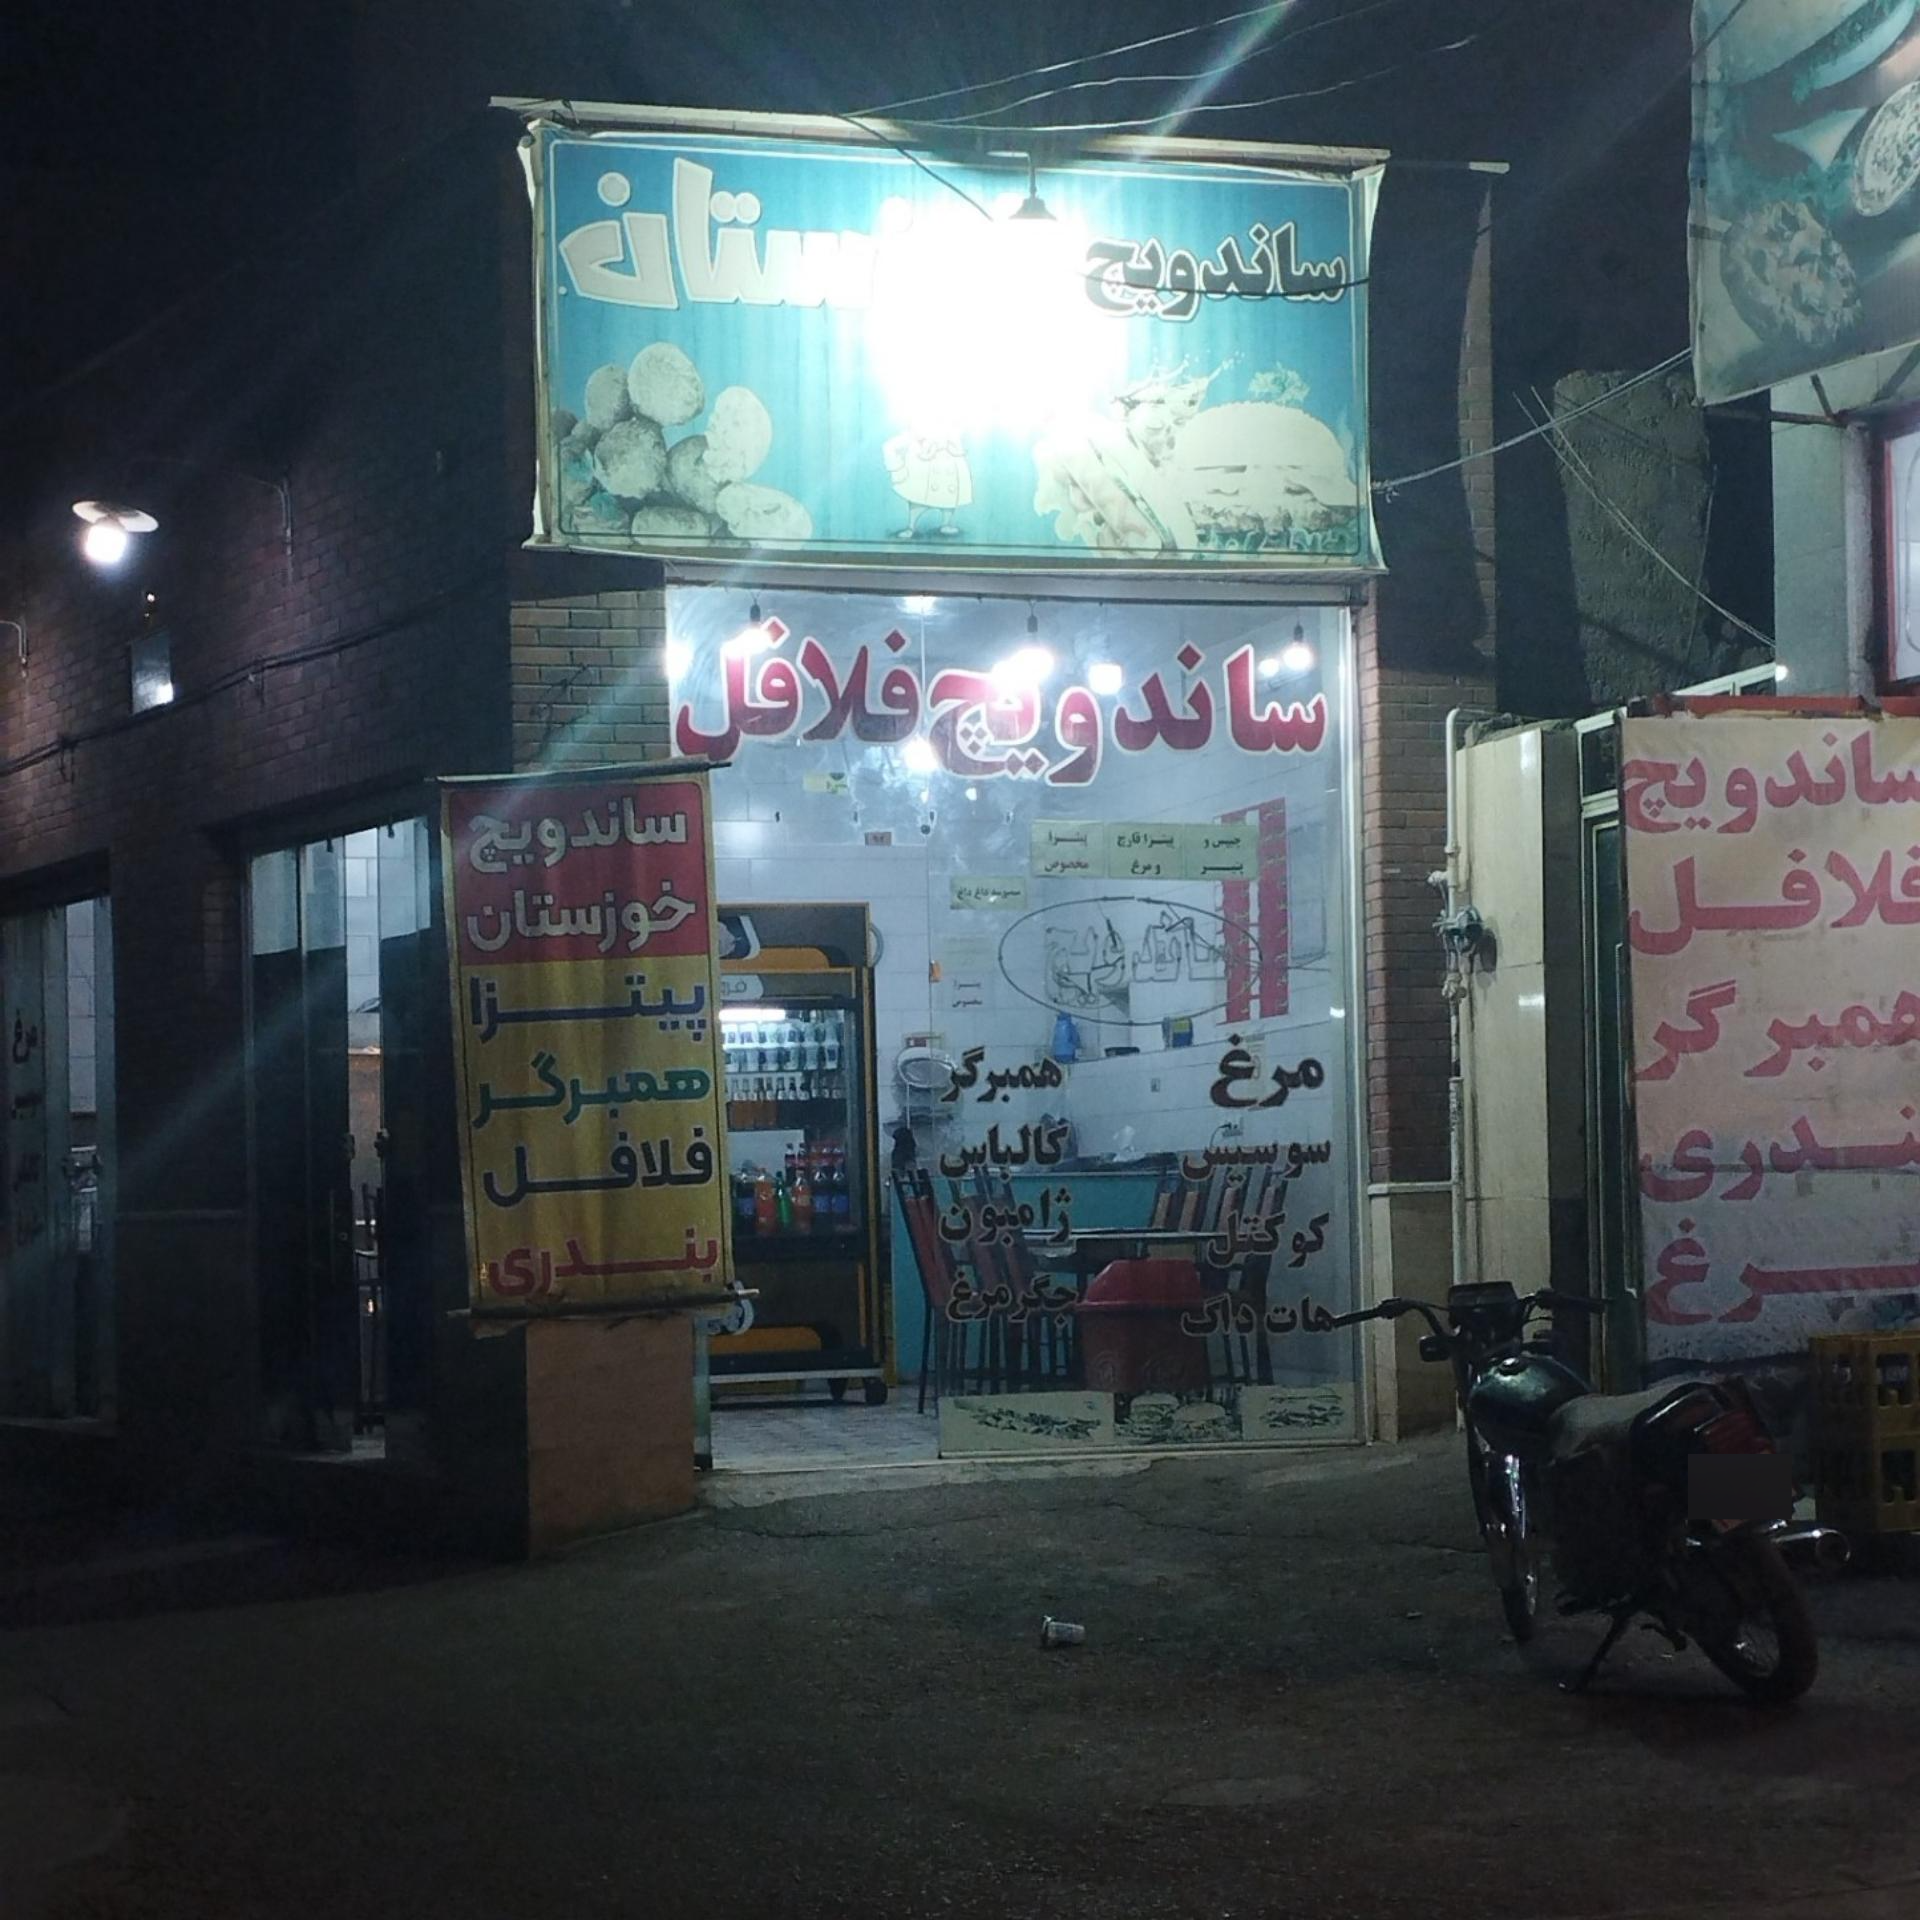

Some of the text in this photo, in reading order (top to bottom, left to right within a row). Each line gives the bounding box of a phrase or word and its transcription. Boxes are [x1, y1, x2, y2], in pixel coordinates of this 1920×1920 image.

[1084, 222, 1346, 321] ساندویچ
[675, 616, 1327, 786] ساندویچ فلافل
[469, 797, 687, 872] ساندویچ
[467, 880, 696, 951] خوزستان
[470, 974, 706, 1042] پیتزا
[472, 1051, 711, 1128] همبرگر
[940, 1046, 1065, 1103] همبرگر
[1210, 1033, 1325, 1109] مرغ
[482, 1127, 713, 1207] فلافل
[940, 1122, 1070, 1185] کالباس
[1181, 1139, 1331, 1183] سوسیس
[1641, 1104, 1920, 1201] ندری
[939, 1187, 1072, 1247] ژامبون
[1208, 1212, 1330, 1268] کوکتل
[487, 1228, 718, 1297] بندری
[1645, 1219, 1920, 1325] رغ
[1265, 1295, 1333, 1333] هات
